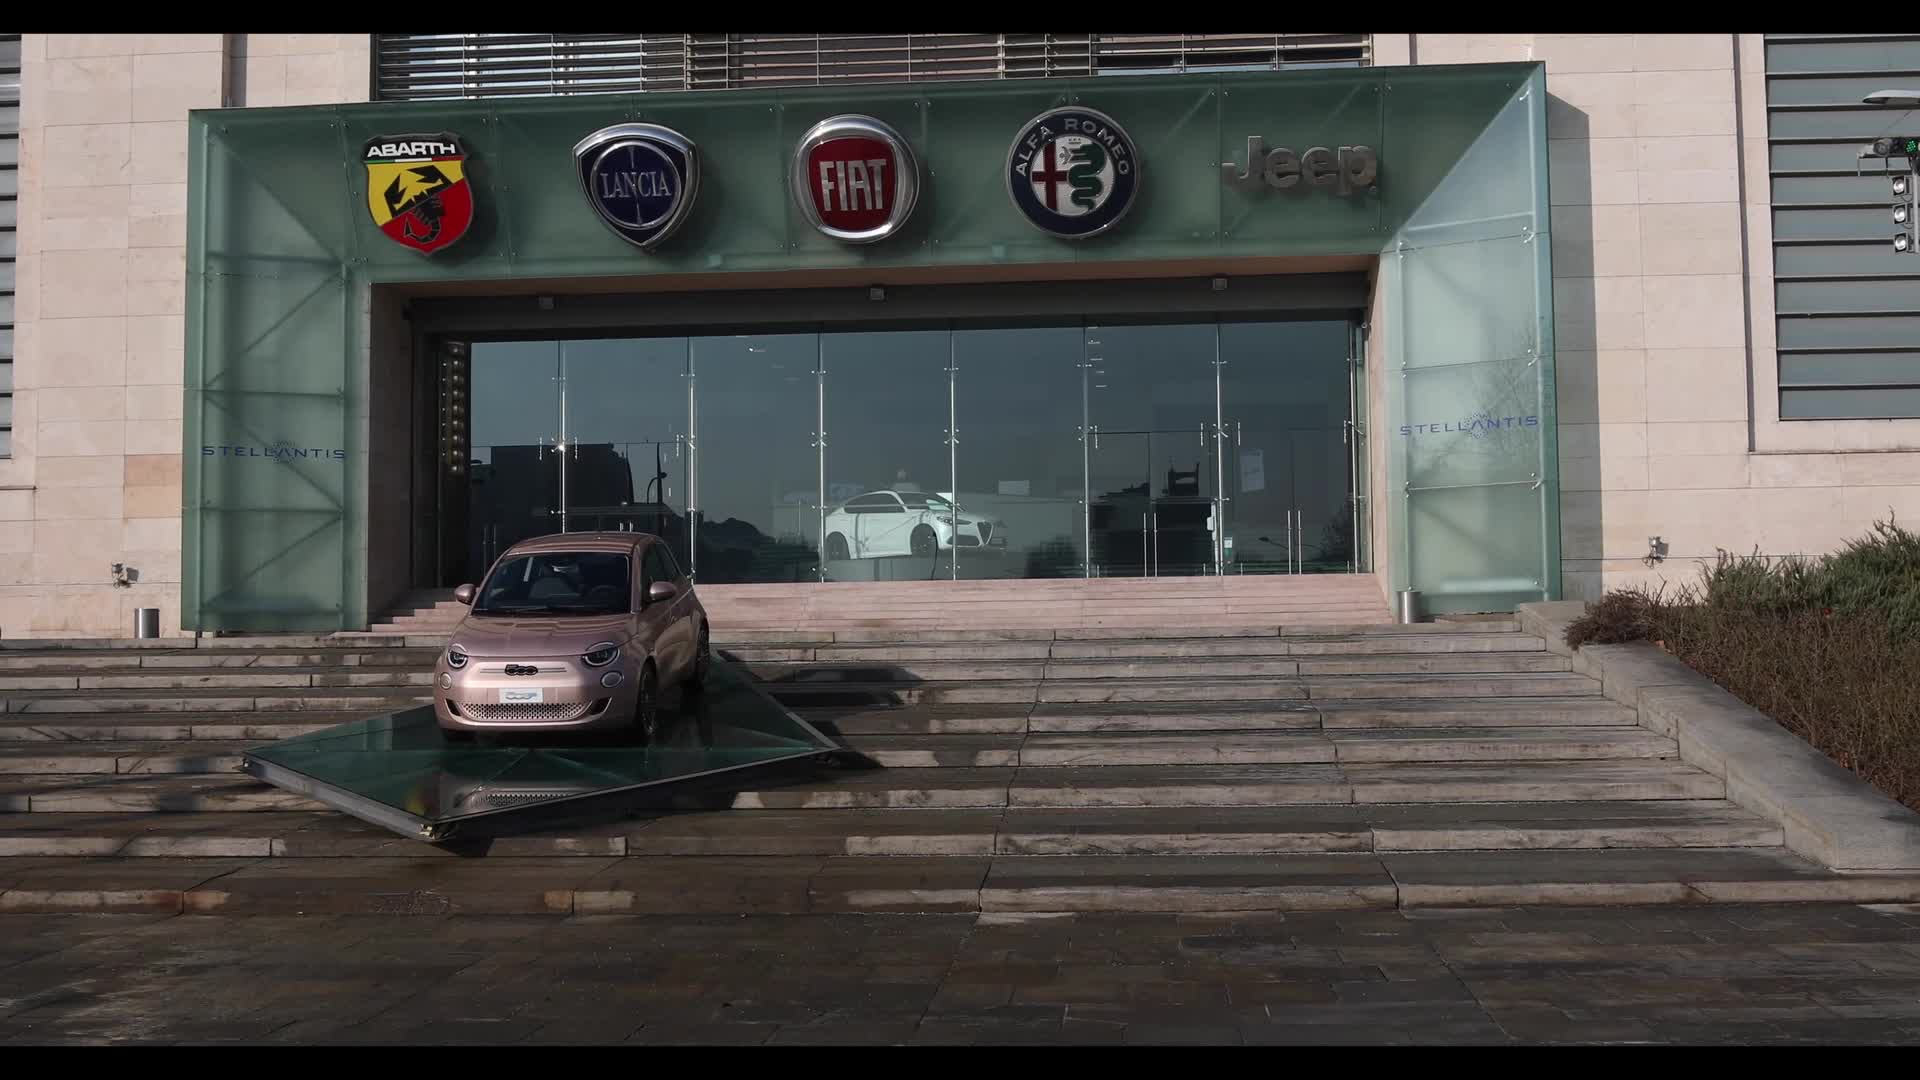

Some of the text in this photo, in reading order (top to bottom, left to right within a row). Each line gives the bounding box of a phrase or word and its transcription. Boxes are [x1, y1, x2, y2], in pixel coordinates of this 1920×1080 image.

[367, 141, 455, 158] ABARTH
[1015, 118, 1128, 177] ALFA ROMEO
[1221, 135, 1377, 196] Jeep
[601, 171, 671, 199] LANCIA
[819, 159, 887, 212] FIAT
[1400, 415, 1538, 436] STELLANTIS
[201, 446, 345, 459] STELLANTIS
